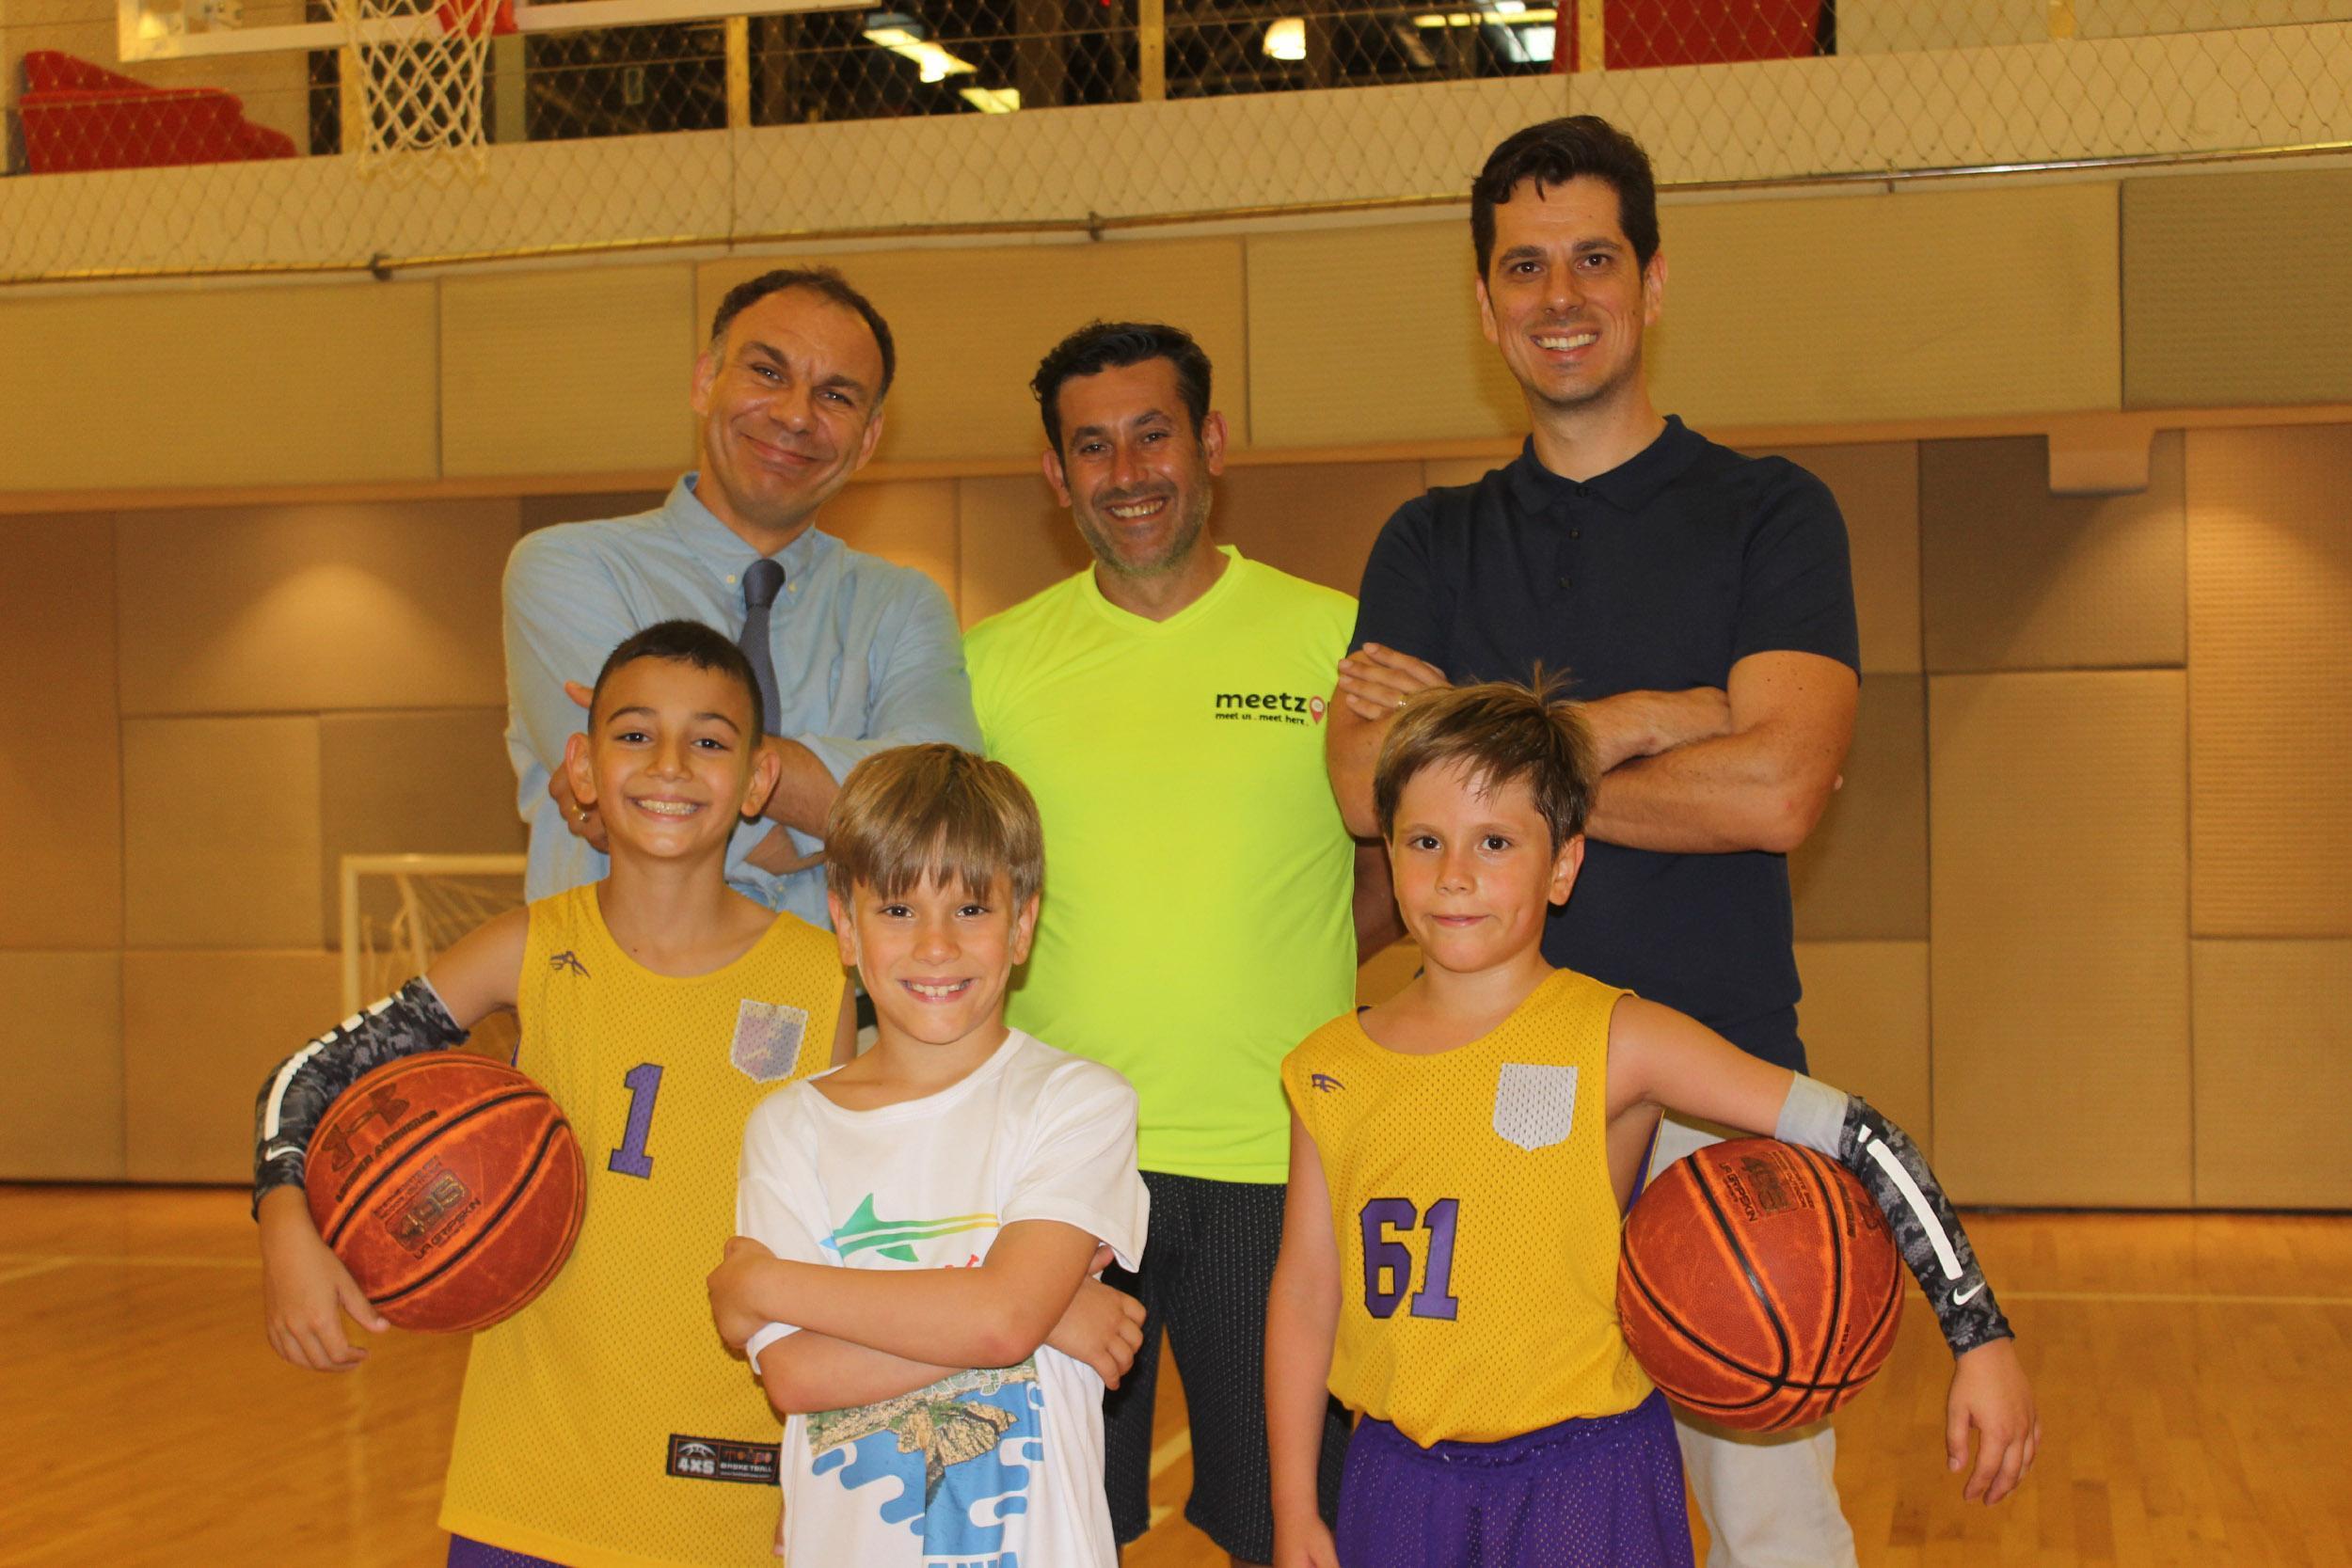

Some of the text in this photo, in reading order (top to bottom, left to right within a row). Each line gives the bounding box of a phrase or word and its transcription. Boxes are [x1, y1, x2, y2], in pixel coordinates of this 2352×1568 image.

[1260, 713, 1282, 722] meet
[608, 1062, 664, 1180] 1
[1359, 1197, 1460, 1322] 61
